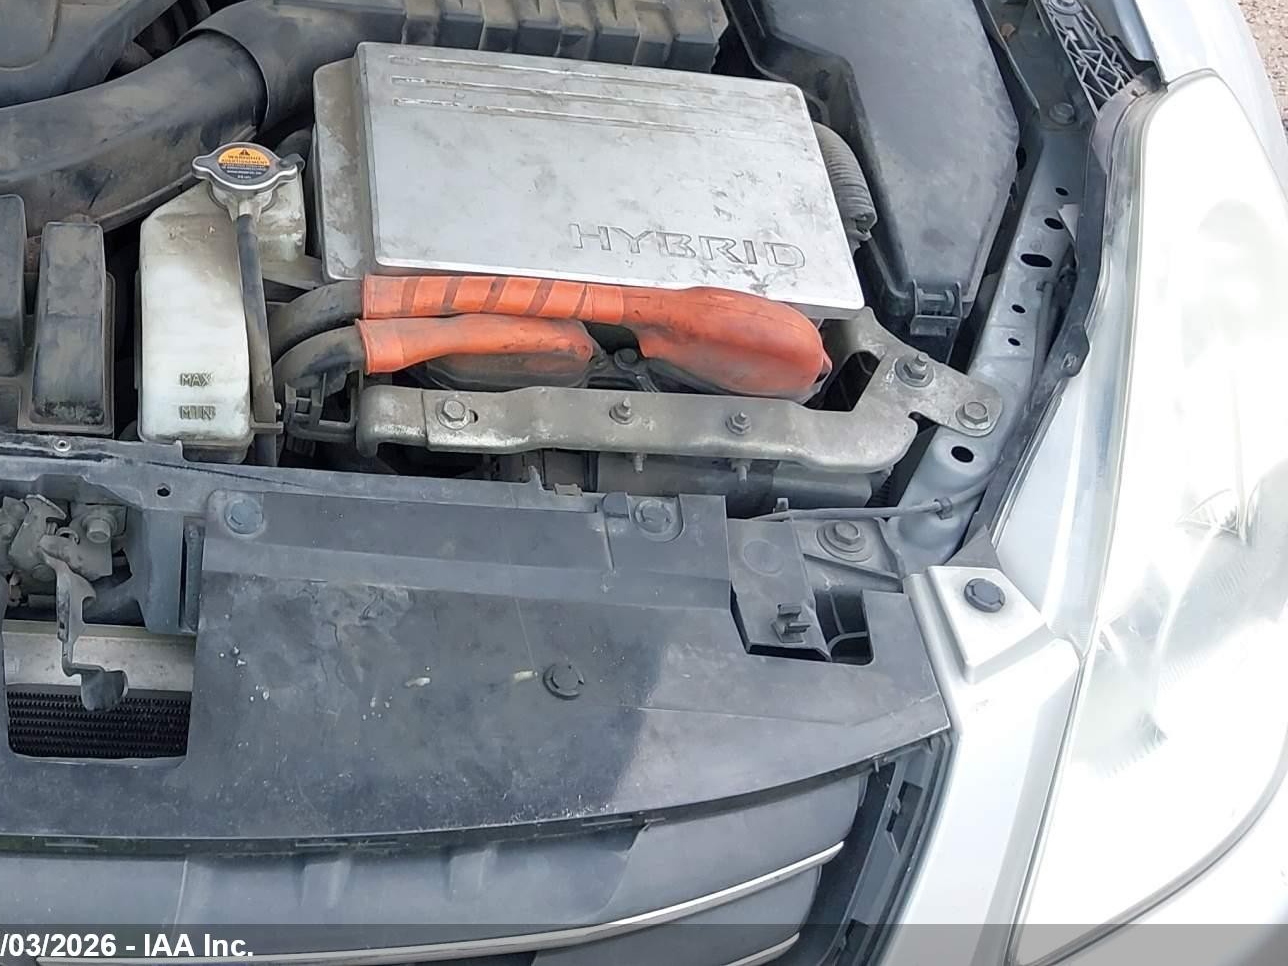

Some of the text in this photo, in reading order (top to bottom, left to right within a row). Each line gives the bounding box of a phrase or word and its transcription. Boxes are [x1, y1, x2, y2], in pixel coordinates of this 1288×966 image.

[568, 223, 805, 269] HYBRID
[179, 372, 212, 387] MAX
[178, 405, 216, 421] MIN
